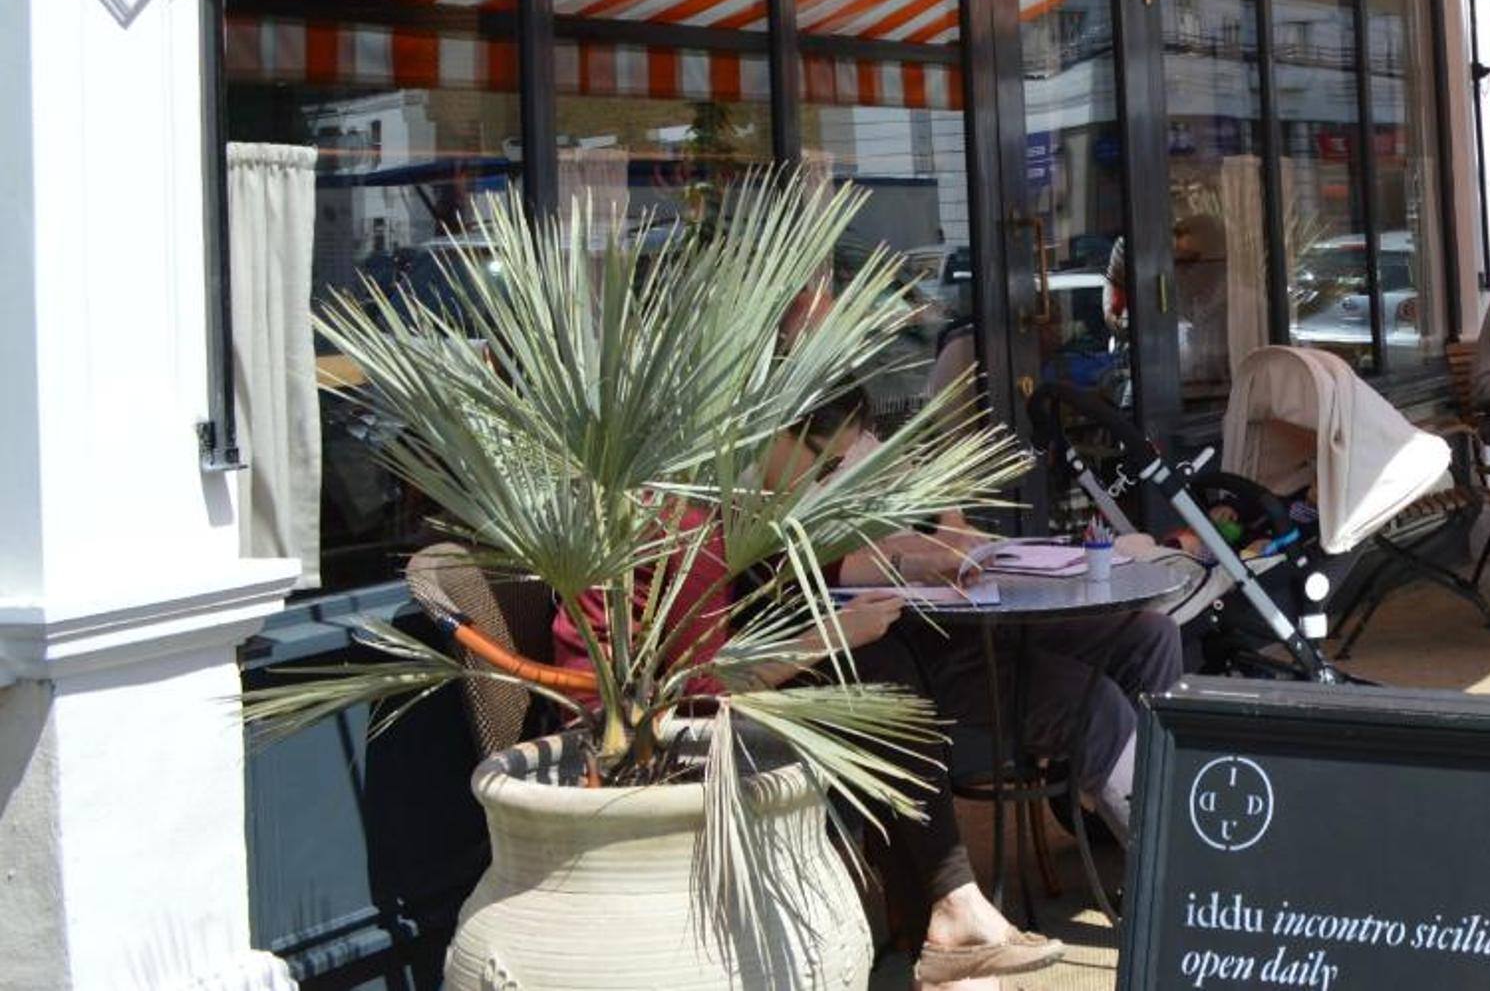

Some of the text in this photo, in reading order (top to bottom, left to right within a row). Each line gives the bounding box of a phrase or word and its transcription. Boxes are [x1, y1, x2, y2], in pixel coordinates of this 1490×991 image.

[1185, 890, 1264, 933] iddu
[1272, 900, 1407, 948] incontro
[1180, 945, 1339, 991] open daily
